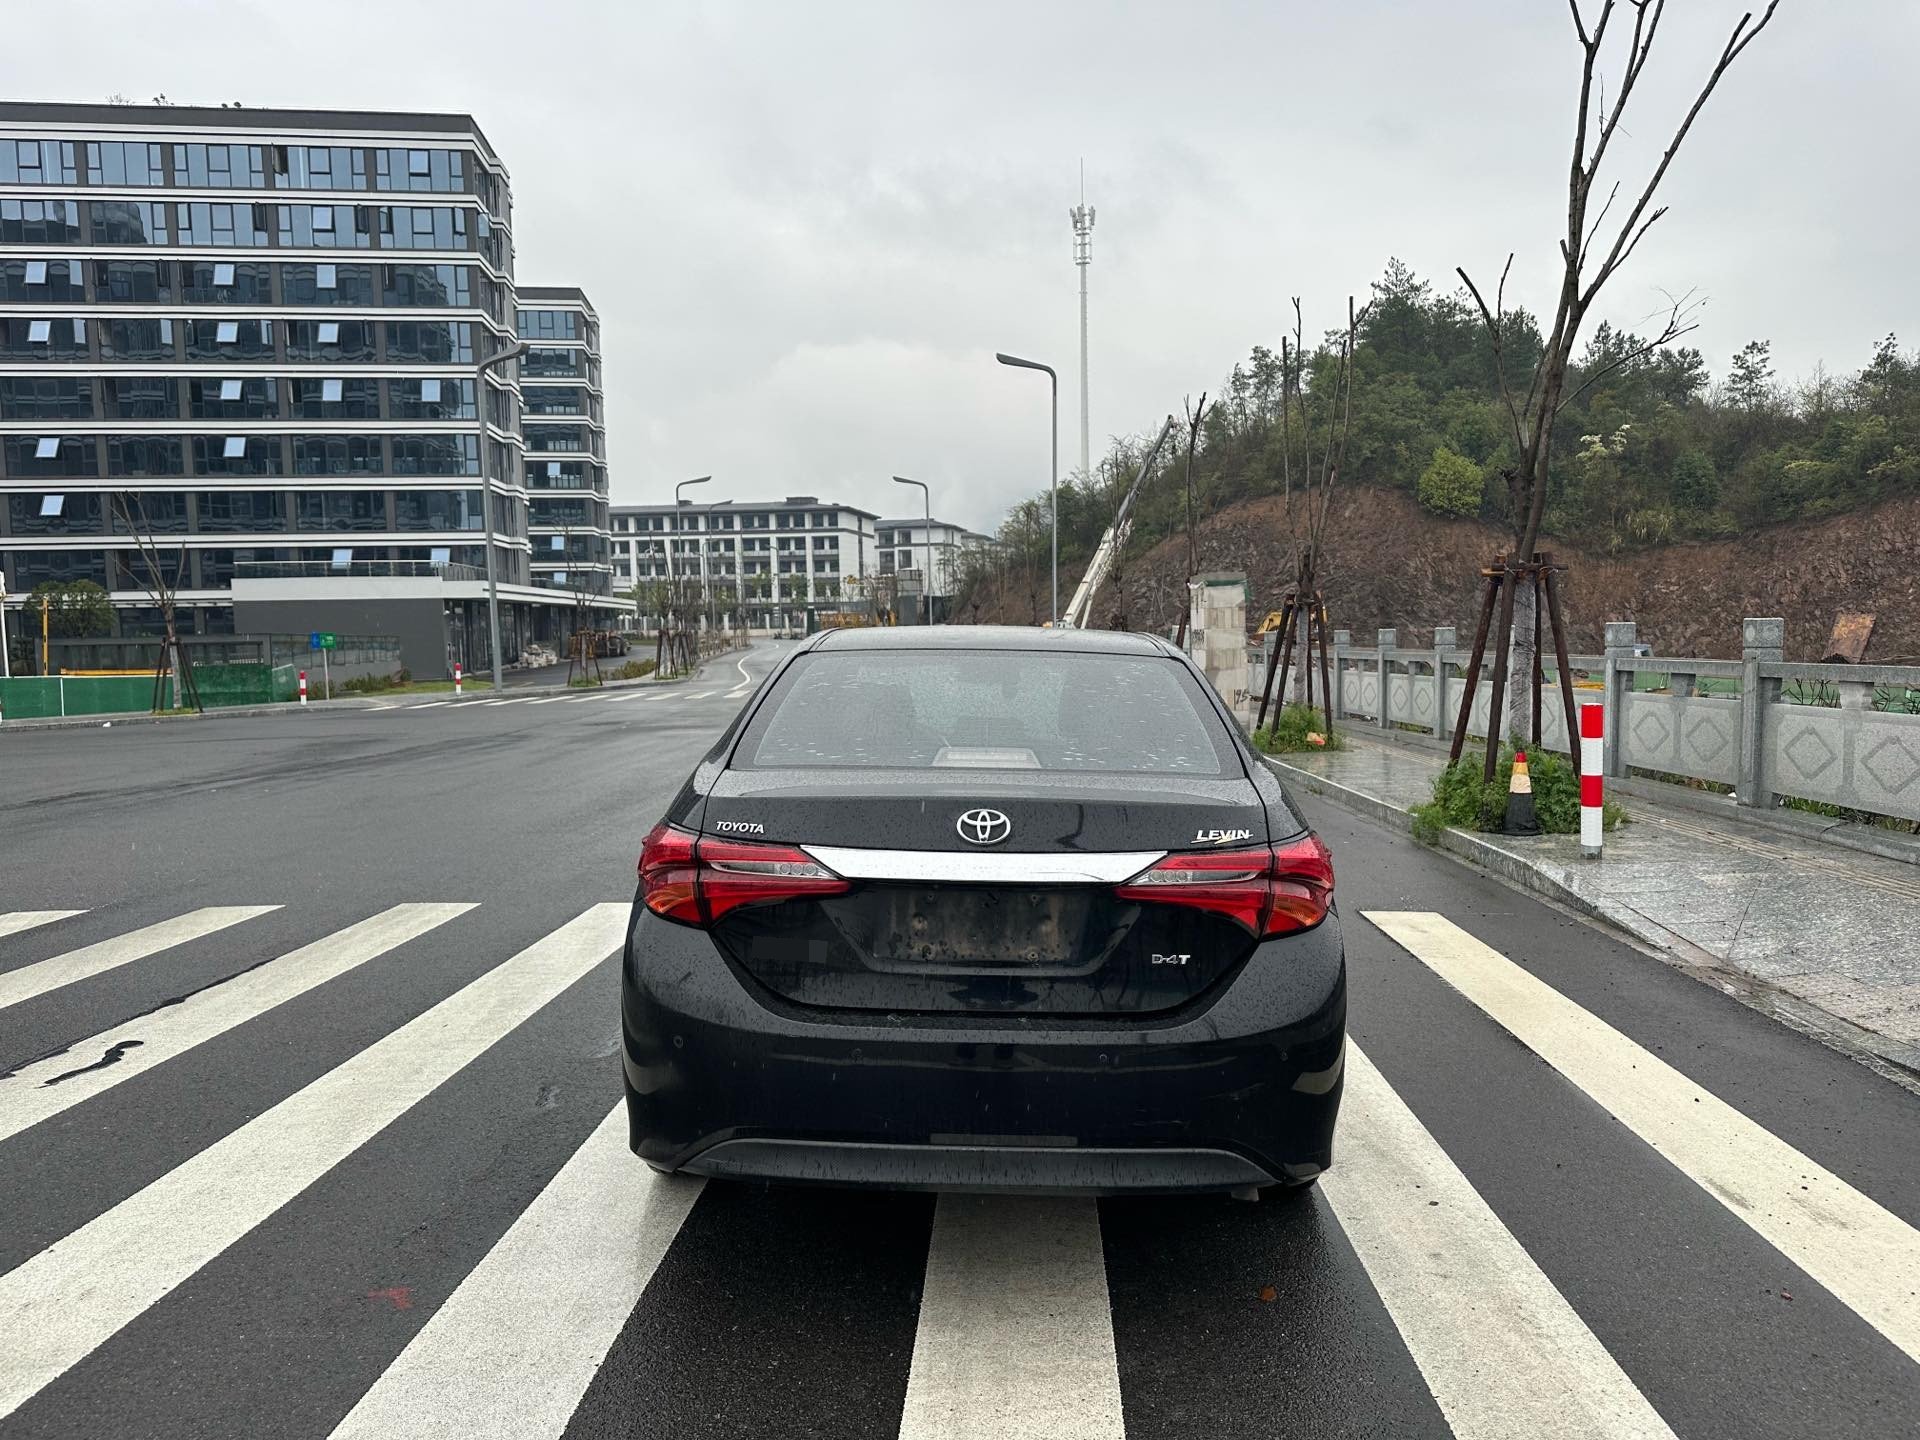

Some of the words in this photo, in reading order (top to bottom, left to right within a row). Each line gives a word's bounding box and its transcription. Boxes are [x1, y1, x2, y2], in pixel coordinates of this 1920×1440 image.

[716, 821, 764, 834] TOYOTA
[1193, 829, 1251, 842] LEVIN
[1151, 954, 1191, 965] D-4T
